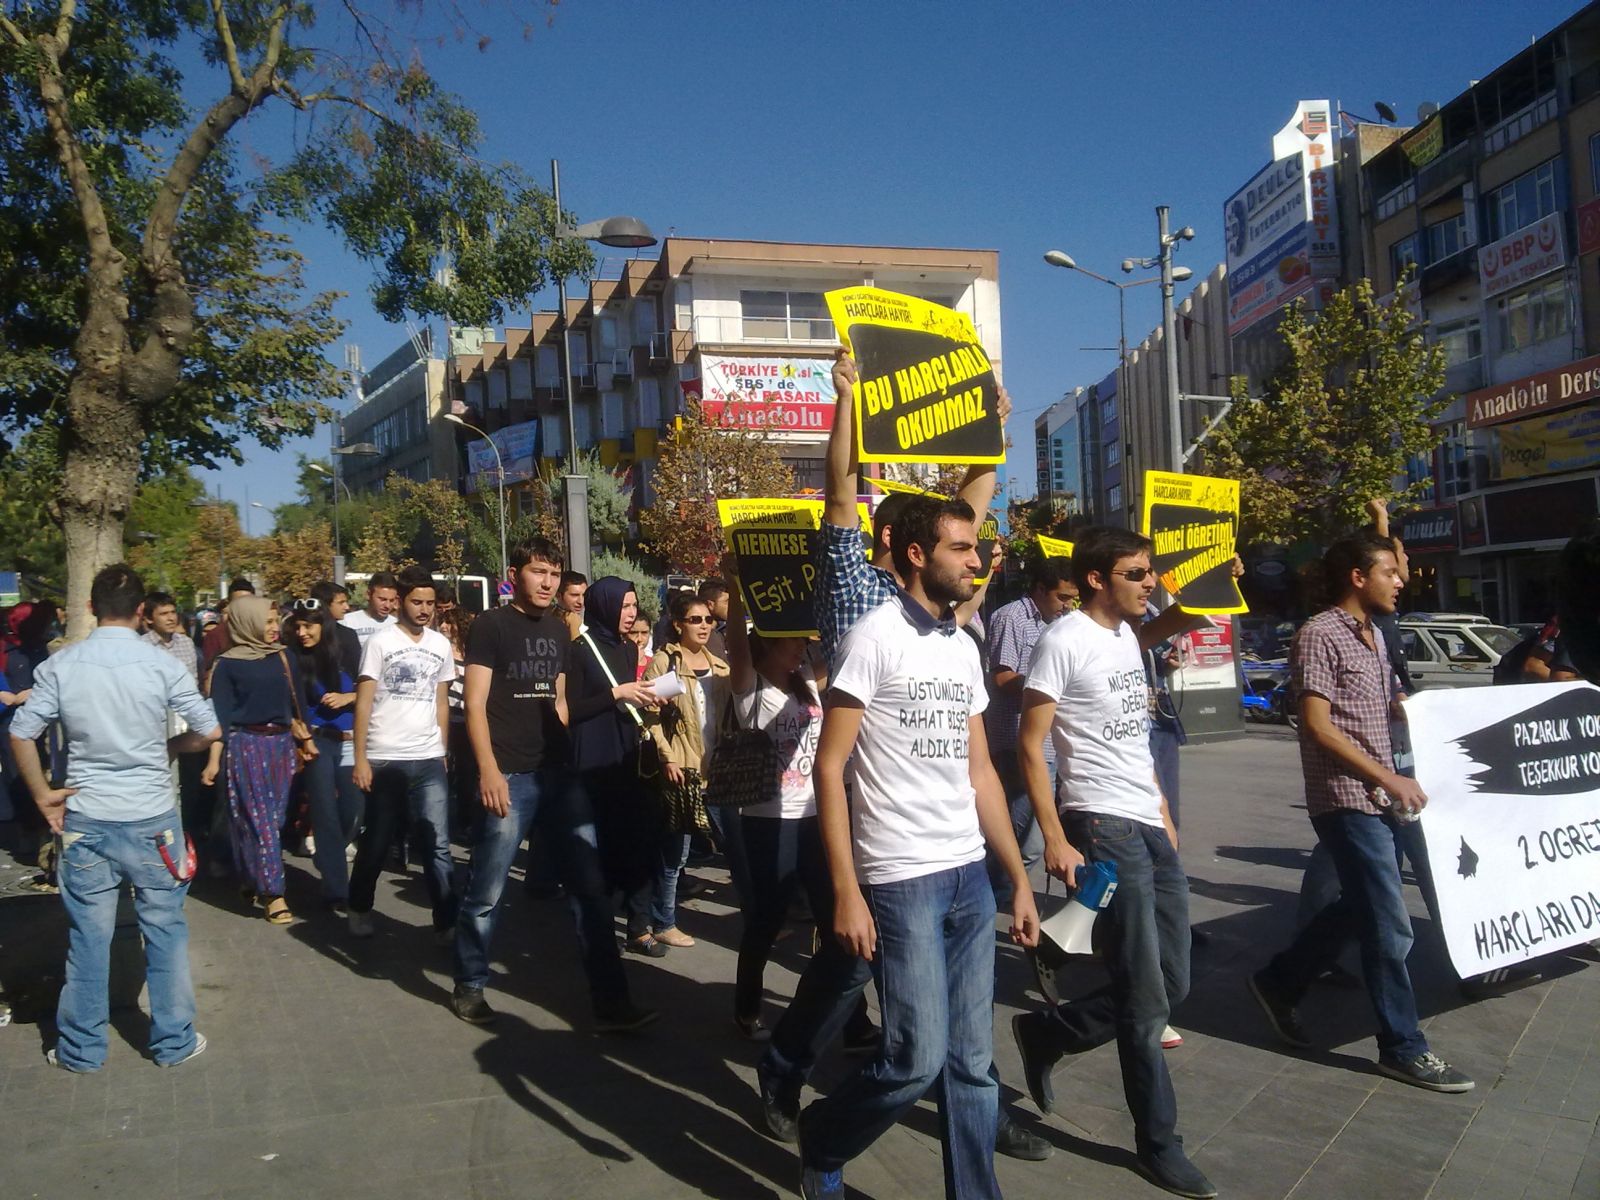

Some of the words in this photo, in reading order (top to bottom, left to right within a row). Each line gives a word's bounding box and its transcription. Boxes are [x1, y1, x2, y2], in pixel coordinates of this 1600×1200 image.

[1501, 234, 1535, 268] BBP
[720, 362, 779, 377] TÜRKİYE
[862, 374, 894, 417] BU
[894, 344, 992, 405] HARÇLARLA
[735, 378, 765, 390] SBS
[1472, 380, 1548, 422] Anadolu
[896, 385, 987, 450] OKUNMAZ
[737, 533, 809, 556] HERKESE
[525, 638, 558, 657] LOS
[534, 682, 550, 691] USA
[907, 677, 966, 703] ÜSTÜMÜZE
[900, 708, 944, 729] RAHAT
[1513, 718, 1572, 748] PAZARLIK
[910, 738, 951, 759] ALDIK
[1474, 900, 1577, 961] HARÇLARI
